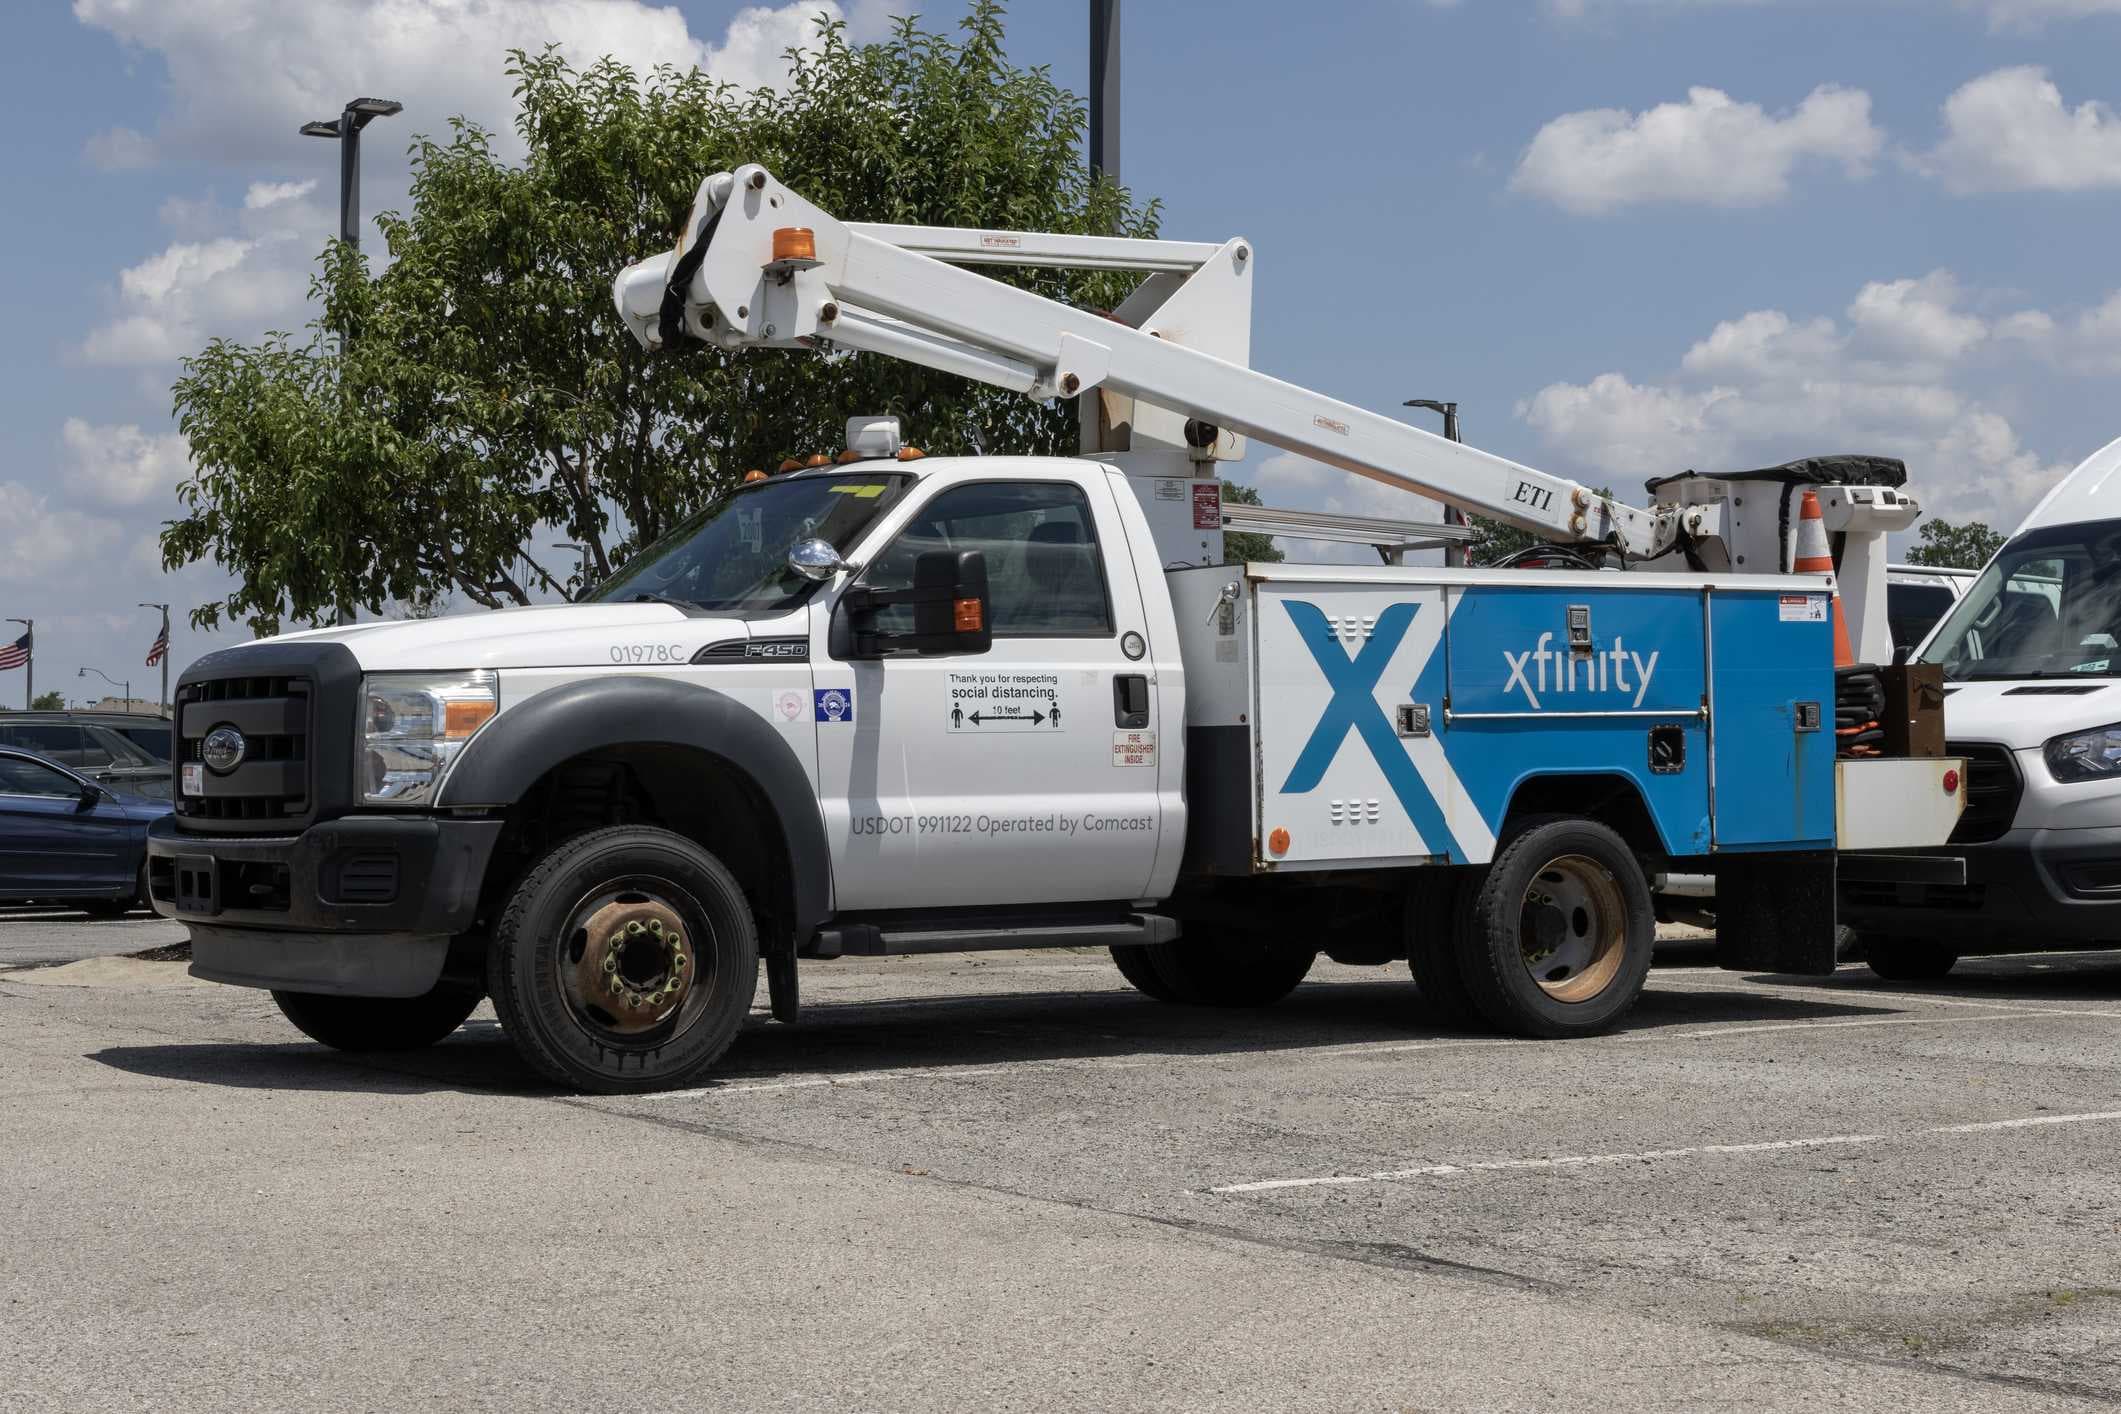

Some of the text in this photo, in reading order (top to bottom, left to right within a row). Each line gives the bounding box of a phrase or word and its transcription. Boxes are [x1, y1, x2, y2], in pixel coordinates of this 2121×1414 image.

[1513, 481, 1554, 511] ETI
[609, 643, 685, 663] 01978C
[1503, 631, 1659, 709] xfinity
[949, 673, 1058, 685] Thank you for respecting
[951, 686, 1058, 701] social distancing.
[992, 705, 1021, 715] 10 feet
[1128, 734, 1141, 743] FIRE
[1115, 744, 1154, 753] EXTINGUISHER
[1124, 754, 1143, 764] INSIDE
[852, 814, 1153, 837] USDOT 991122 Operated by Comcast
